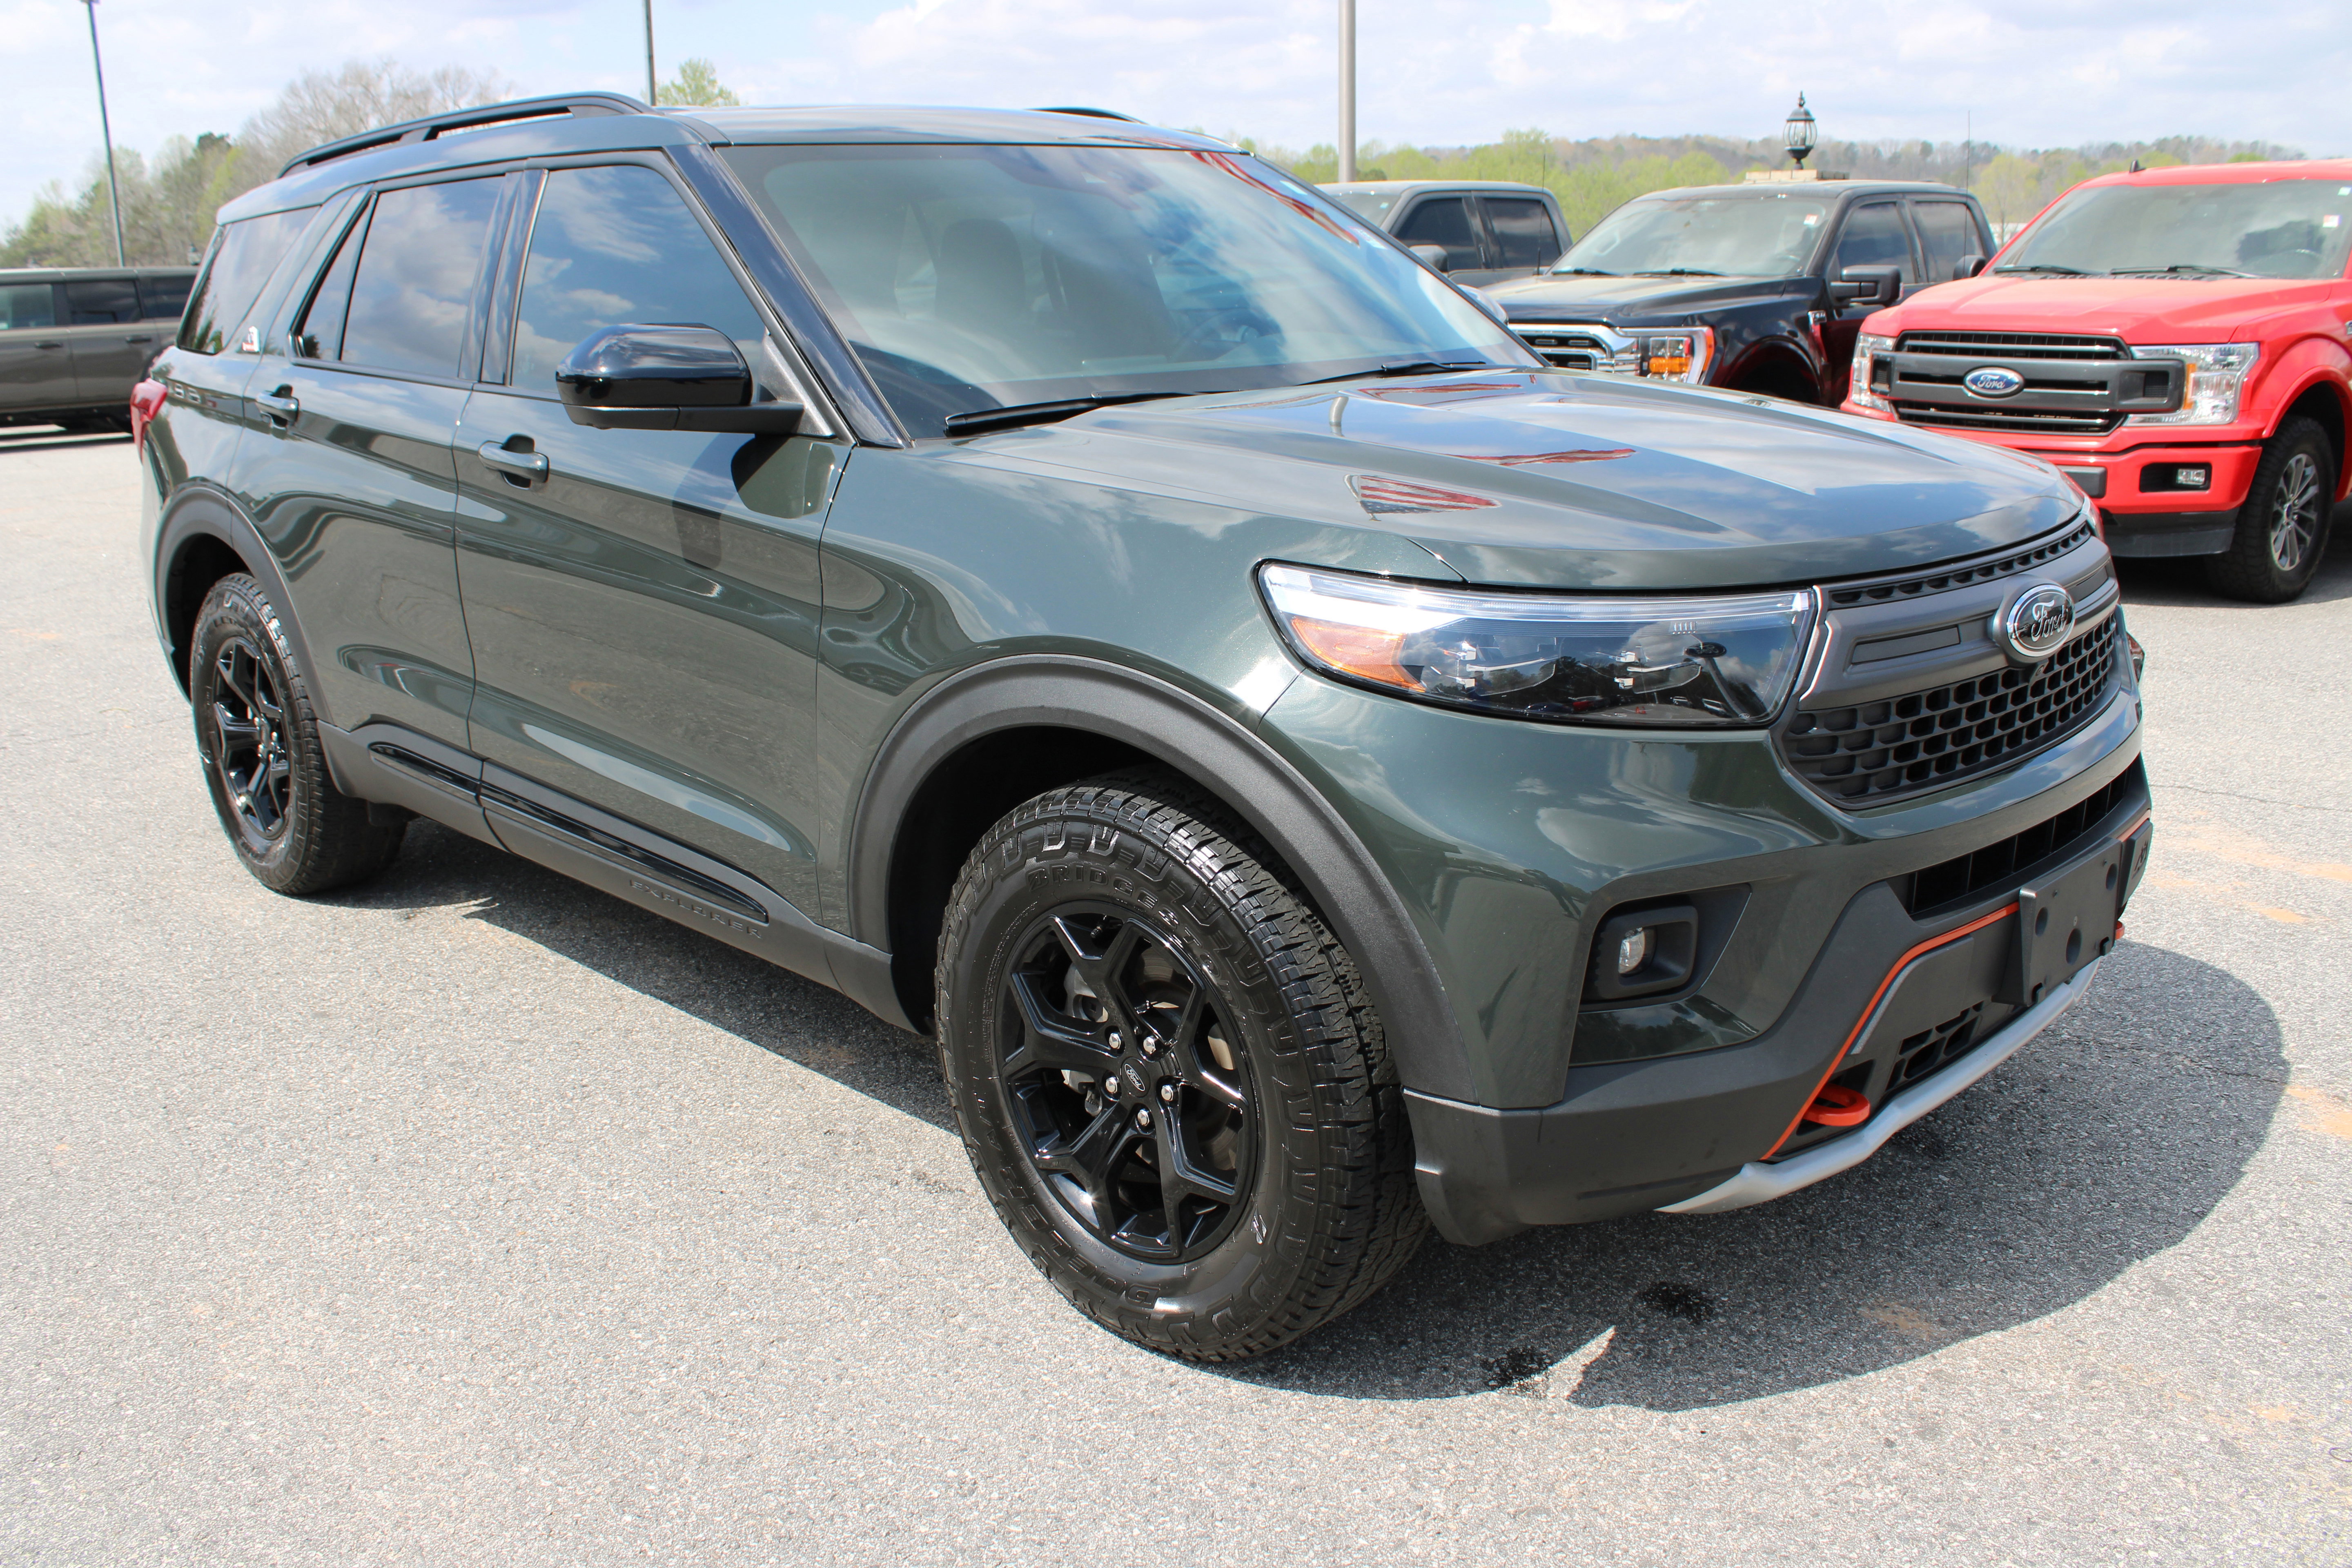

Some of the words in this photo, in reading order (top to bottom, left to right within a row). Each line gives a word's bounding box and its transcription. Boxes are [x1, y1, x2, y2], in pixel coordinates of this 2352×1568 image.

[1977, 374, 2006, 390] Ford
[2031, 599, 2067, 642] Ford
[629, 880, 762, 940] EXPLORER
[1126, 1068, 1142, 1089] Ford
[1001, 1165, 1160, 1309] DUELER
